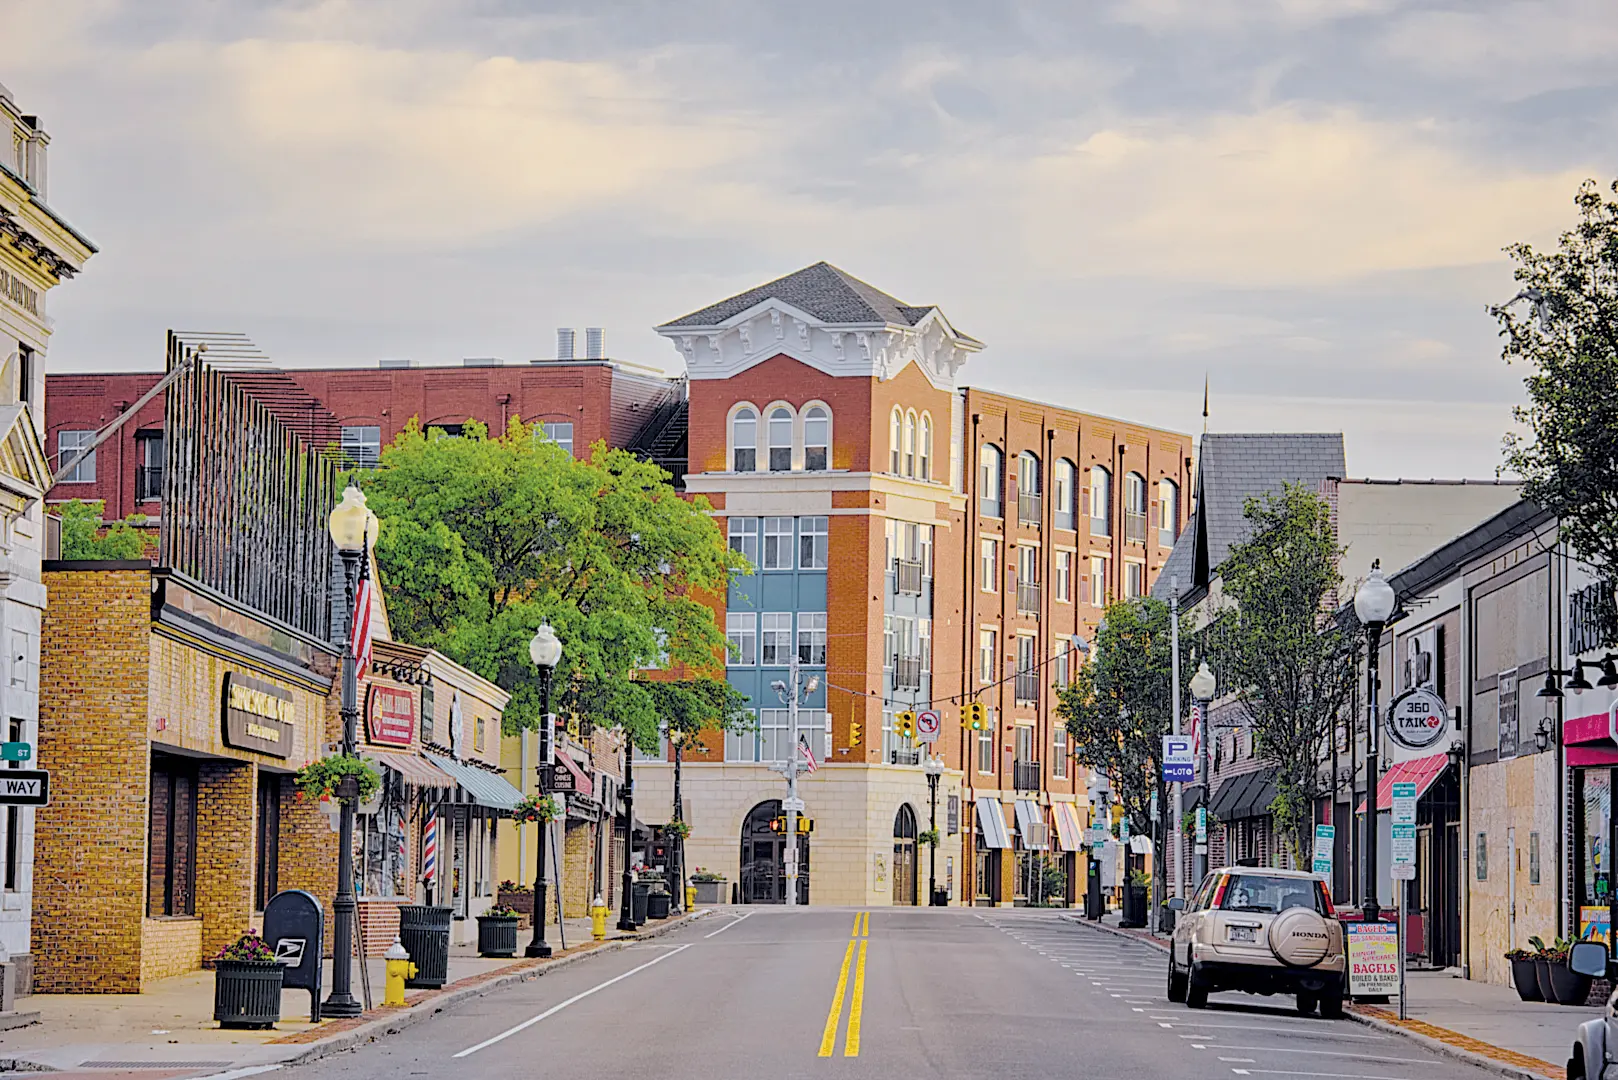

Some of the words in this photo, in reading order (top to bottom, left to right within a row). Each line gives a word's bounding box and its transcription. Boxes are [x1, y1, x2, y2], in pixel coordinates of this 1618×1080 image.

[1406, 702, 1430, 713] 360
[17, 749, 28, 757] ST
[1168, 742, 1188, 756] P
[1172, 768, 1186, 776] LOT
[554, 774, 572, 782] CHINESE
[6, 780, 37, 795] WAY
[1356, 924, 1388, 933] BAGELS
[1292, 931, 1328, 939] HONDA
[1352, 950, 1376, 959] LUNCH
[1353, 963, 1396, 974] BAGELS
